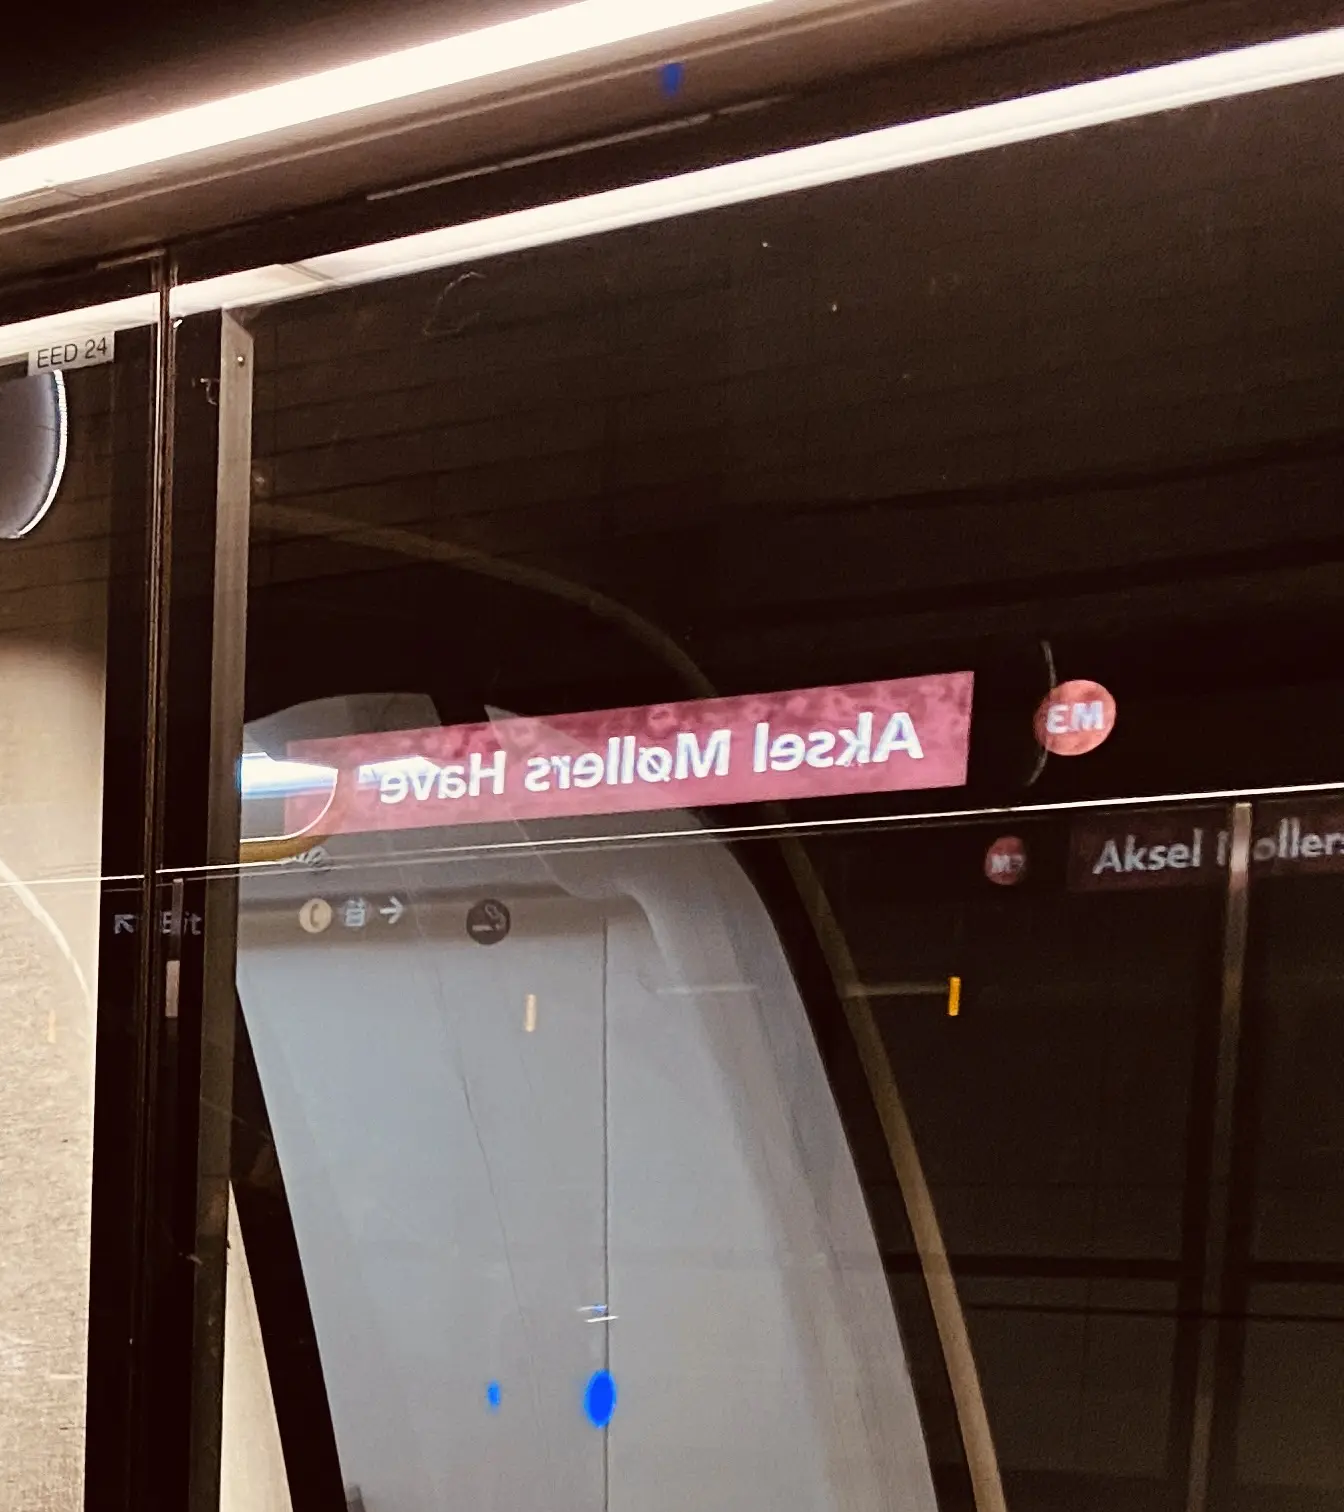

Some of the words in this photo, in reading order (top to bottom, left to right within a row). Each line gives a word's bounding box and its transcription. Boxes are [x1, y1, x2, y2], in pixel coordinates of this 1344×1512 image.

[37, 343, 78, 369] EED
[84, 336, 108, 360] 24
[1093, 827, 1203, 875] Aksel
